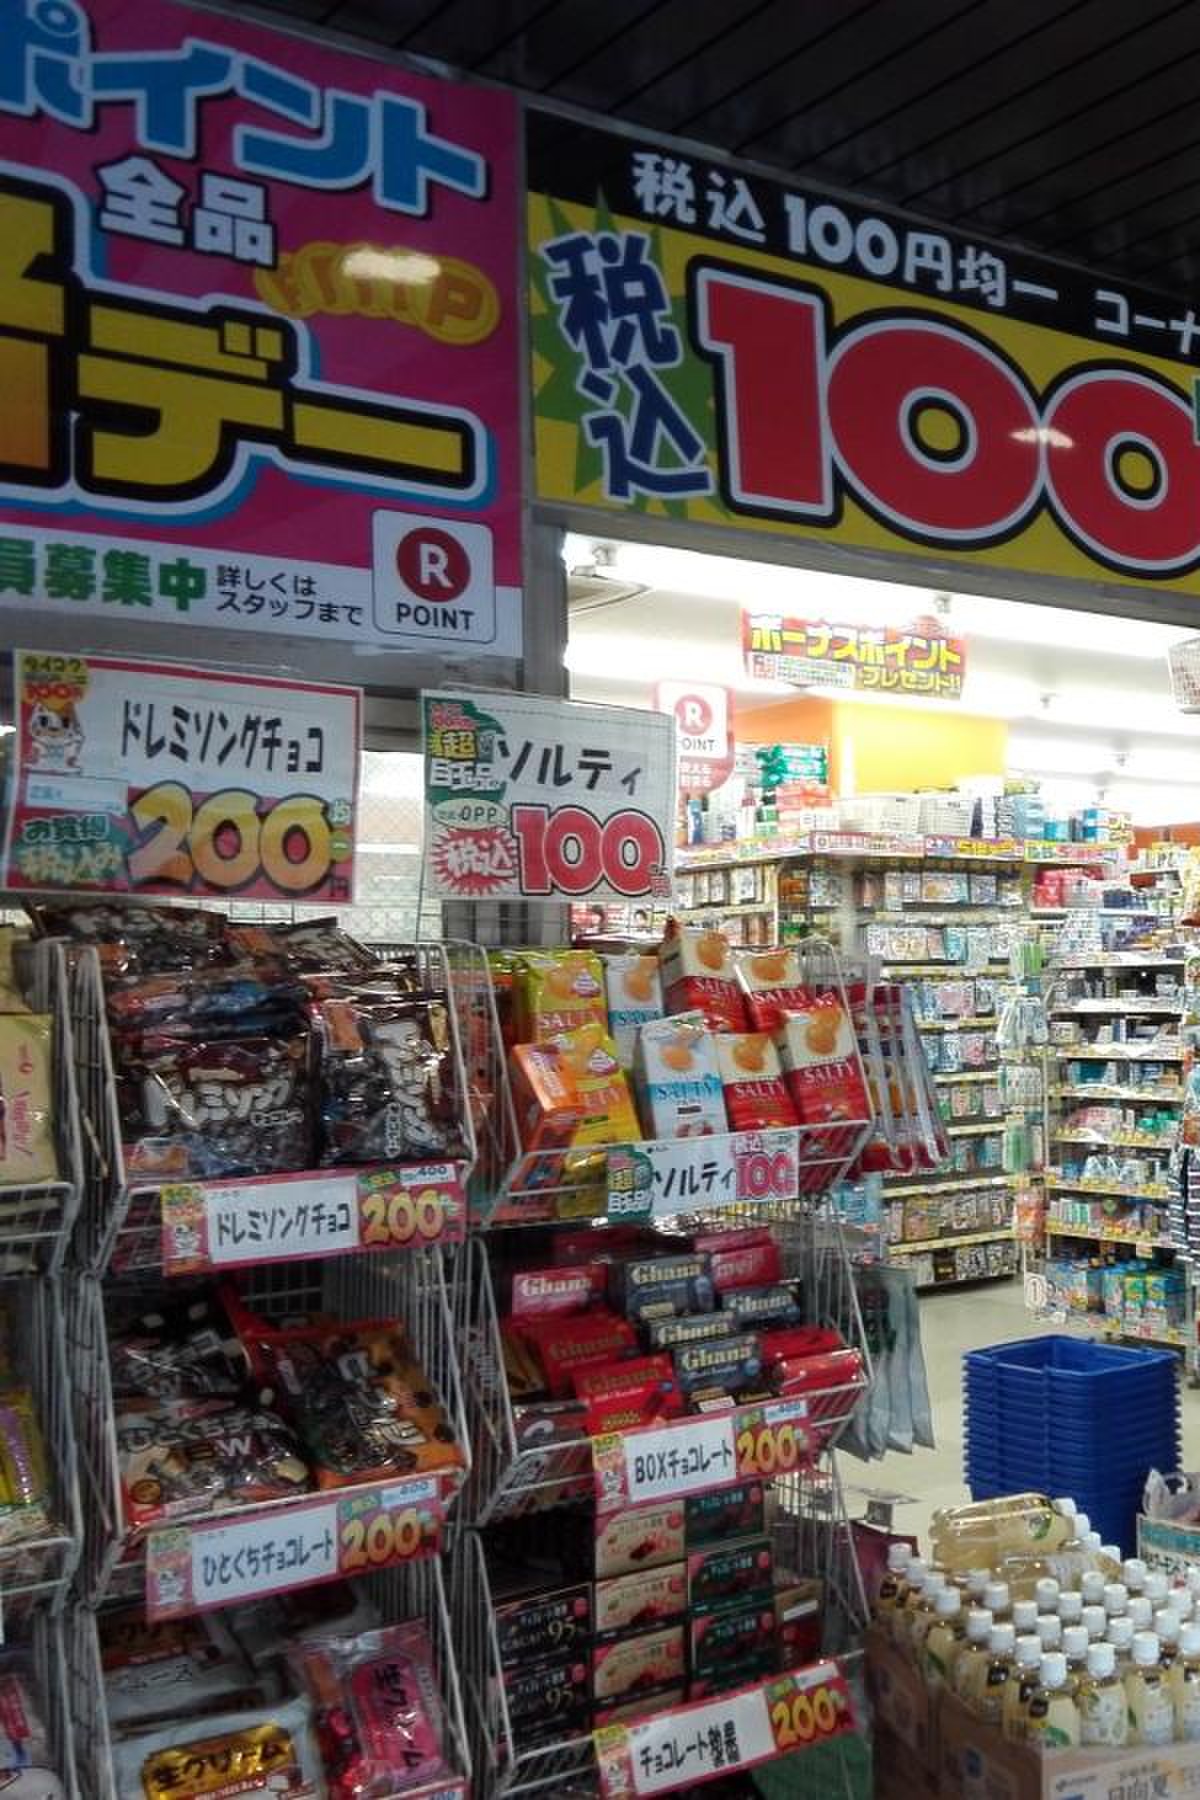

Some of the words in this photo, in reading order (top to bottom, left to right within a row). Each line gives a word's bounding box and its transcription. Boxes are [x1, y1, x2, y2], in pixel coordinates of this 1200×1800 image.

[97, 156, 275, 267] 全品
[631, 150, 766, 244] 税込
[784, 195, 1059, 308] 100円均一
[540, 230, 712, 504] 税込
[216, 564, 316, 597] 詳しくは
[215, 590, 364, 627] スタッフまで
[396, 603, 475, 632] POINT
[751, 626, 961, 668] ボーナスポイント
[676, 737, 715, 752] OINT
[498, 740, 642, 796] ソルティ
[128, 780, 334, 898] 200
[510, 803, 666, 897] 100
[734, 1082, 785, 1100] SALTY
[802, 1065, 855, 1086] SALTY
[653, 1160, 736, 1198] ソルティ
[361, 1189, 446, 1244] 200
[521, 1277, 592, 1297] Ghana
[631, 1261, 702, 1285] Ghana
[729, 1294, 793, 1312] Ghana
[658, 1321, 730, 1345] Ghana
[681, 1345, 753, 1371] Ghana
[635, 1439, 733, 1483] BOXチョコレート
[738, 1424, 798, 1473] 200
[202, 1526, 335, 1586] ひとくちチョコレート
[341, 1508, 420, 1569] 200
[772, 1692, 836, 1744] 200
[640, 1720, 741, 1777] チョコレート効果
